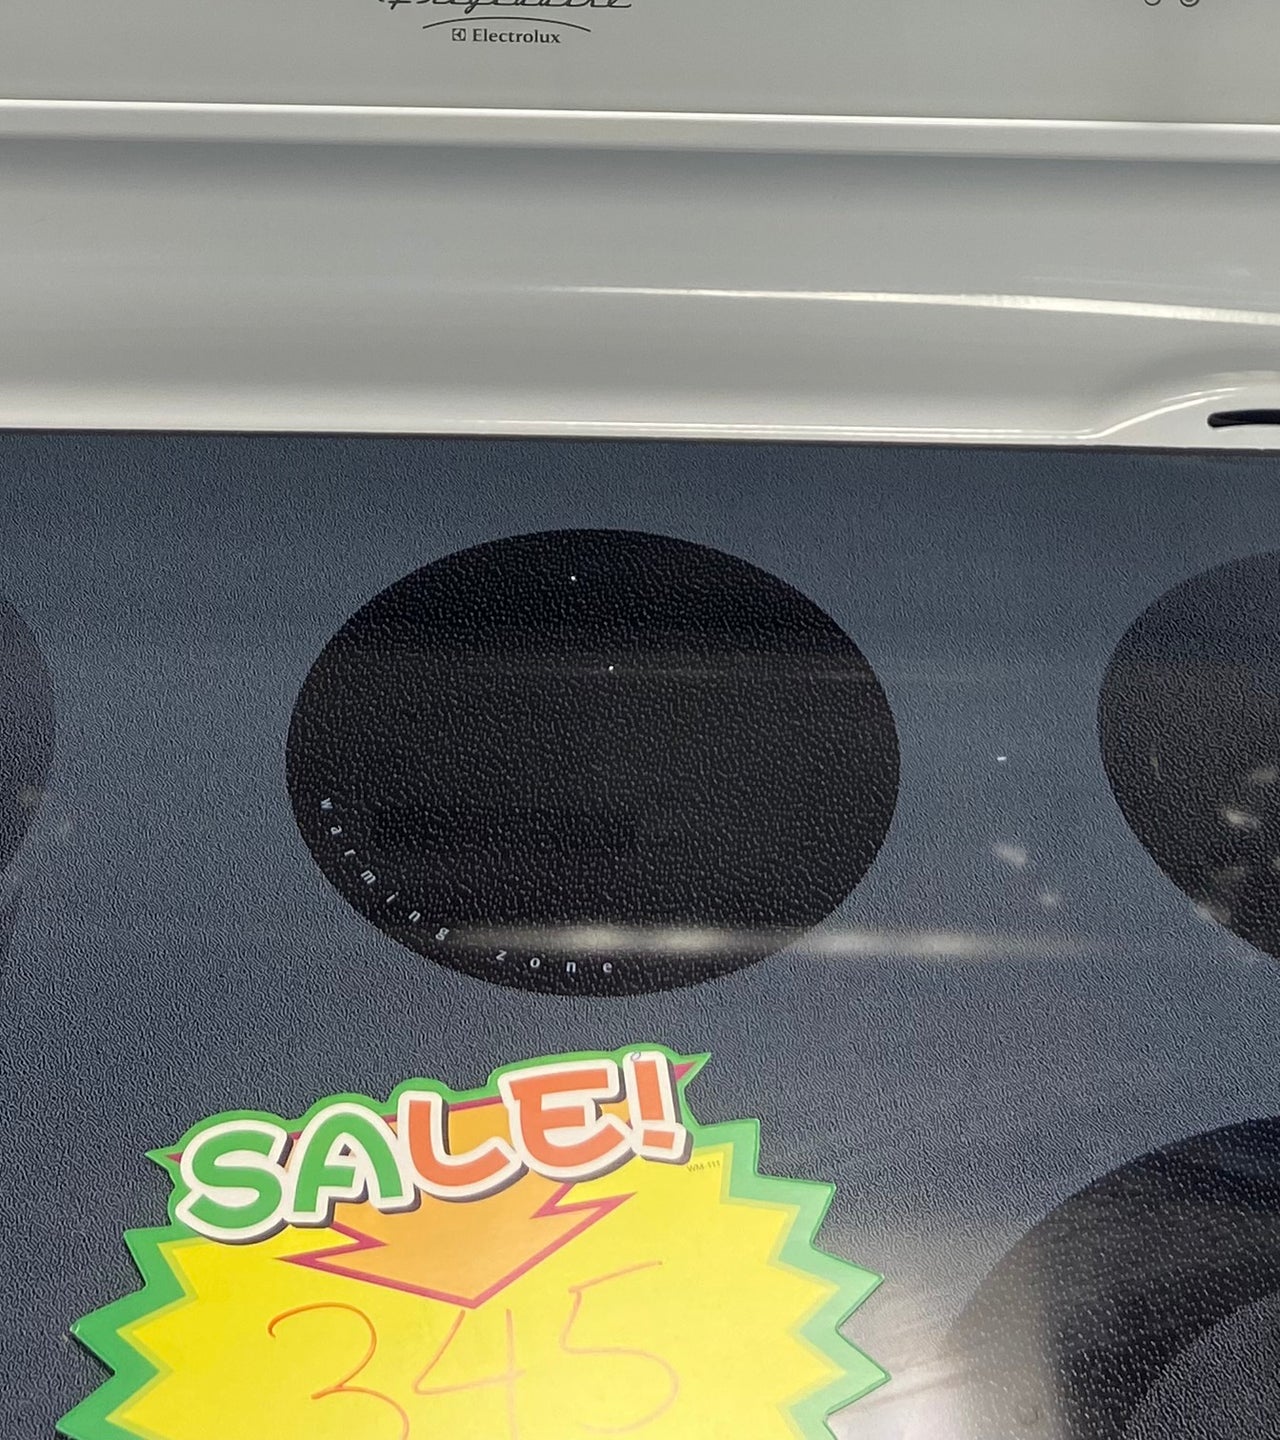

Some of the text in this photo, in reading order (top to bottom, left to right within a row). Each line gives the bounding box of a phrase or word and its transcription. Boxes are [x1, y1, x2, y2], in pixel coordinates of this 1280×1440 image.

[472, 28, 561, 44] Electrolux
[320, 797, 613, 973] warming zone
[176, 1050, 688, 1242] SALE!
